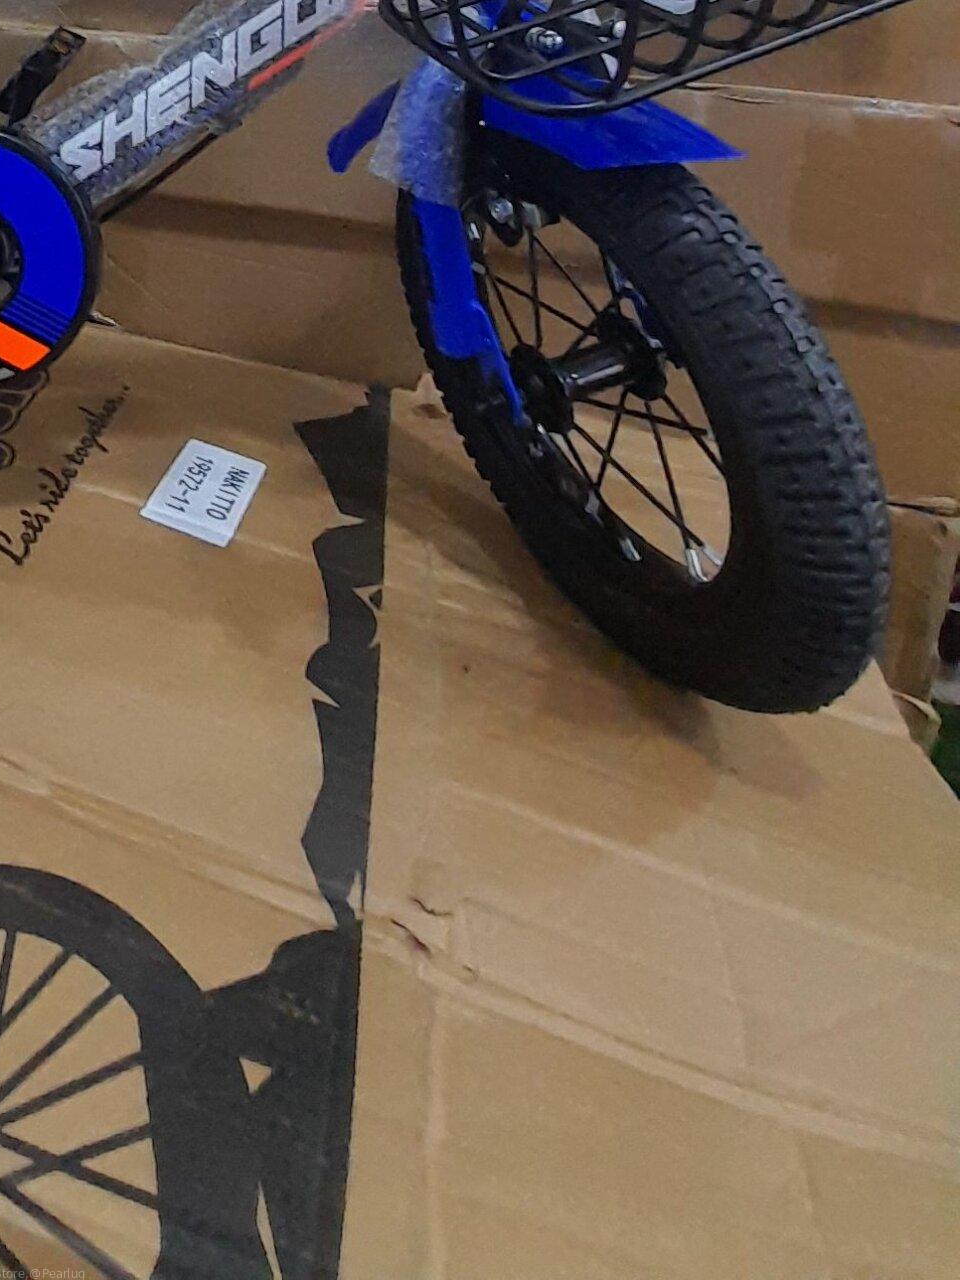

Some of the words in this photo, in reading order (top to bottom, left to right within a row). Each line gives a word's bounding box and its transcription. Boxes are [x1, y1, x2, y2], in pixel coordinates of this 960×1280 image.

[40, 468, 77, 515] ride
[165, 454, 214, 514] 19572-11
[206, 465, 250, 521] NAKITTO
